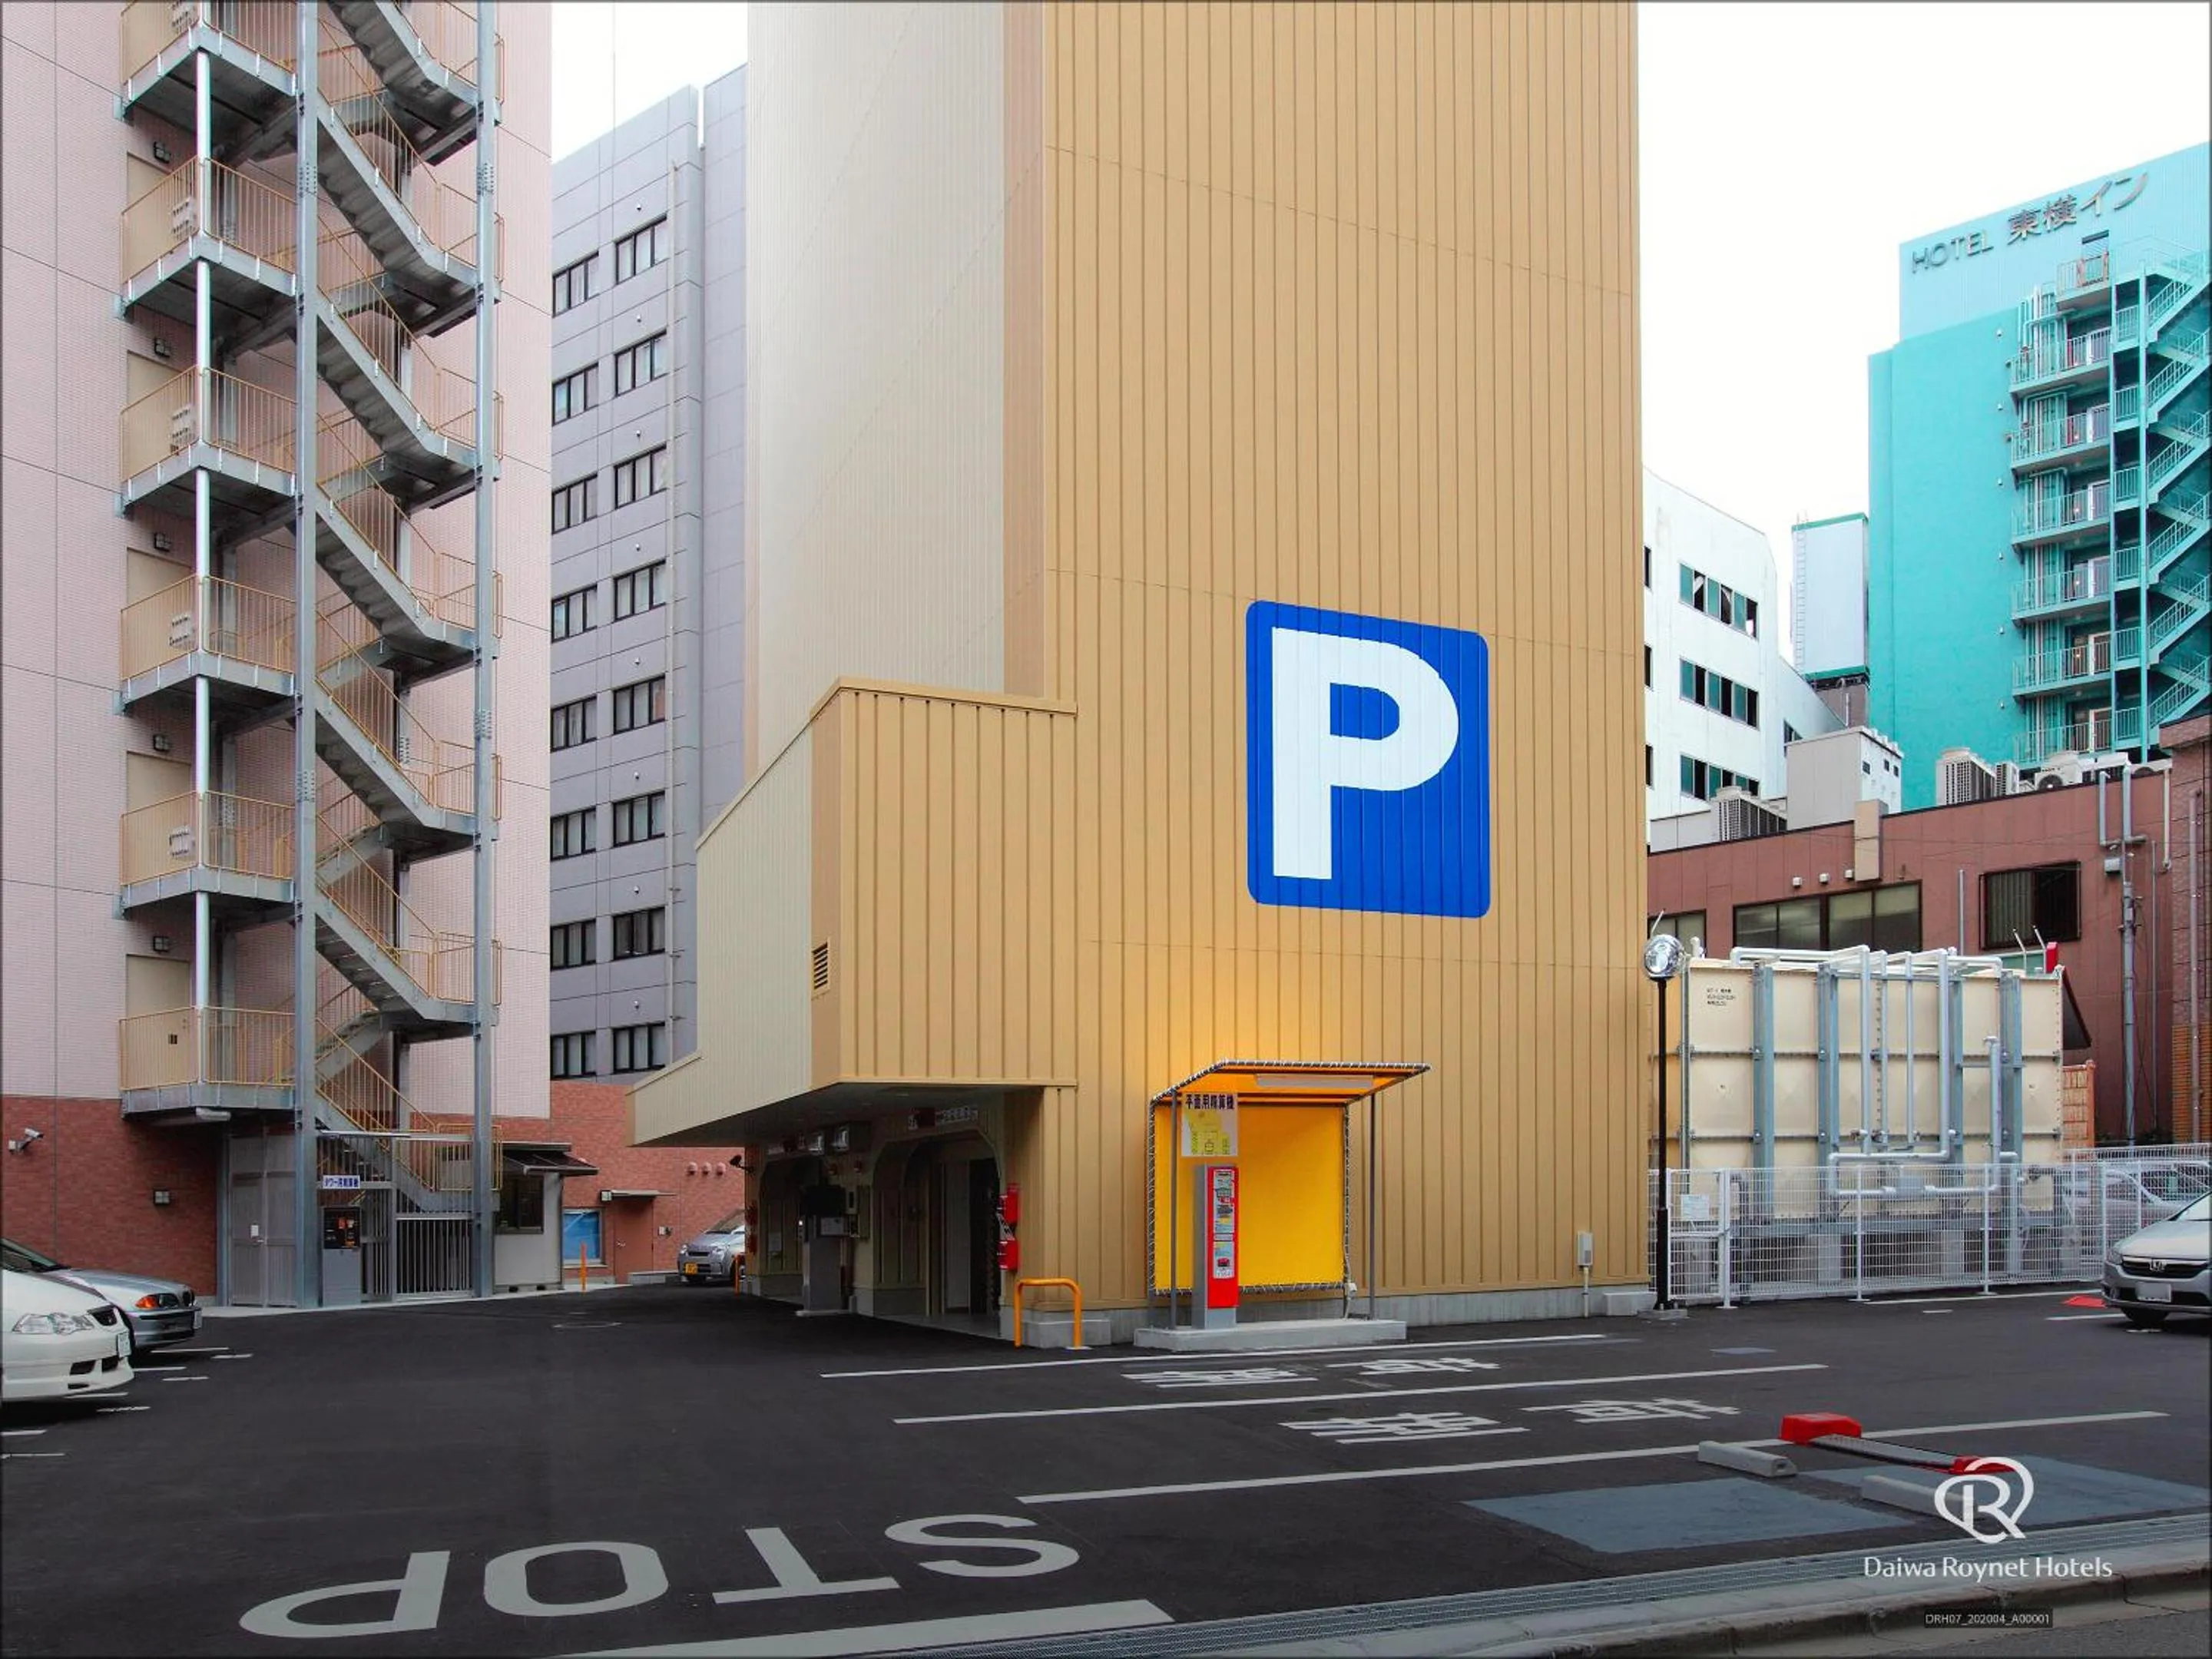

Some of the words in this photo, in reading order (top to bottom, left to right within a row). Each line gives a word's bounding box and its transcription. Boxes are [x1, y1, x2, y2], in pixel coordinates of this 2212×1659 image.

[1912, 230, 1994, 273] HOTEL
[2006, 171, 2148, 246] 東横イン
[1272, 627, 1459, 880] P
[238, 1513, 1081, 1638] STOP
